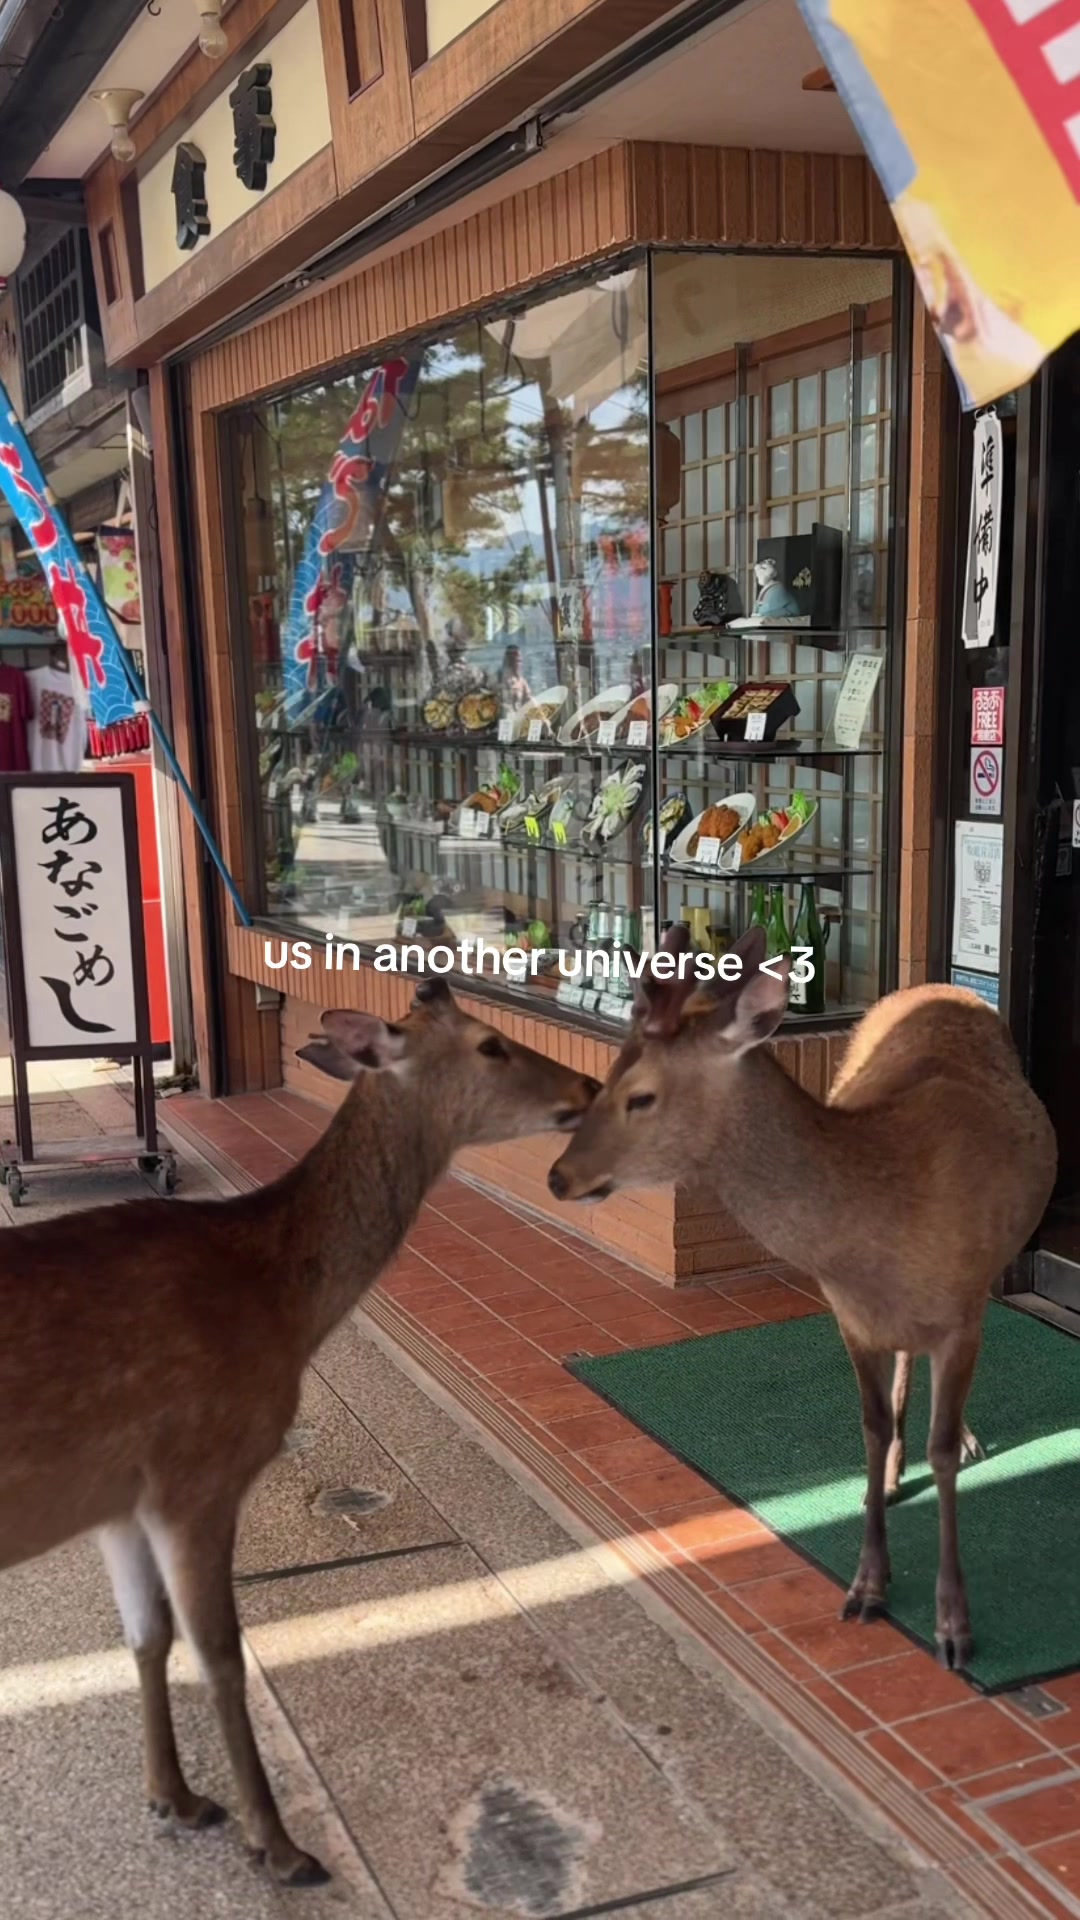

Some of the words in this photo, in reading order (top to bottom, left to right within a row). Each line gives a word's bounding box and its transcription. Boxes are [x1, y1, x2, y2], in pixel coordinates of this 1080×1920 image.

[973, 435, 995, 621] 準備中
[976, 711, 998, 729] FREE
[37, 796, 116, 1034] あなごめし
